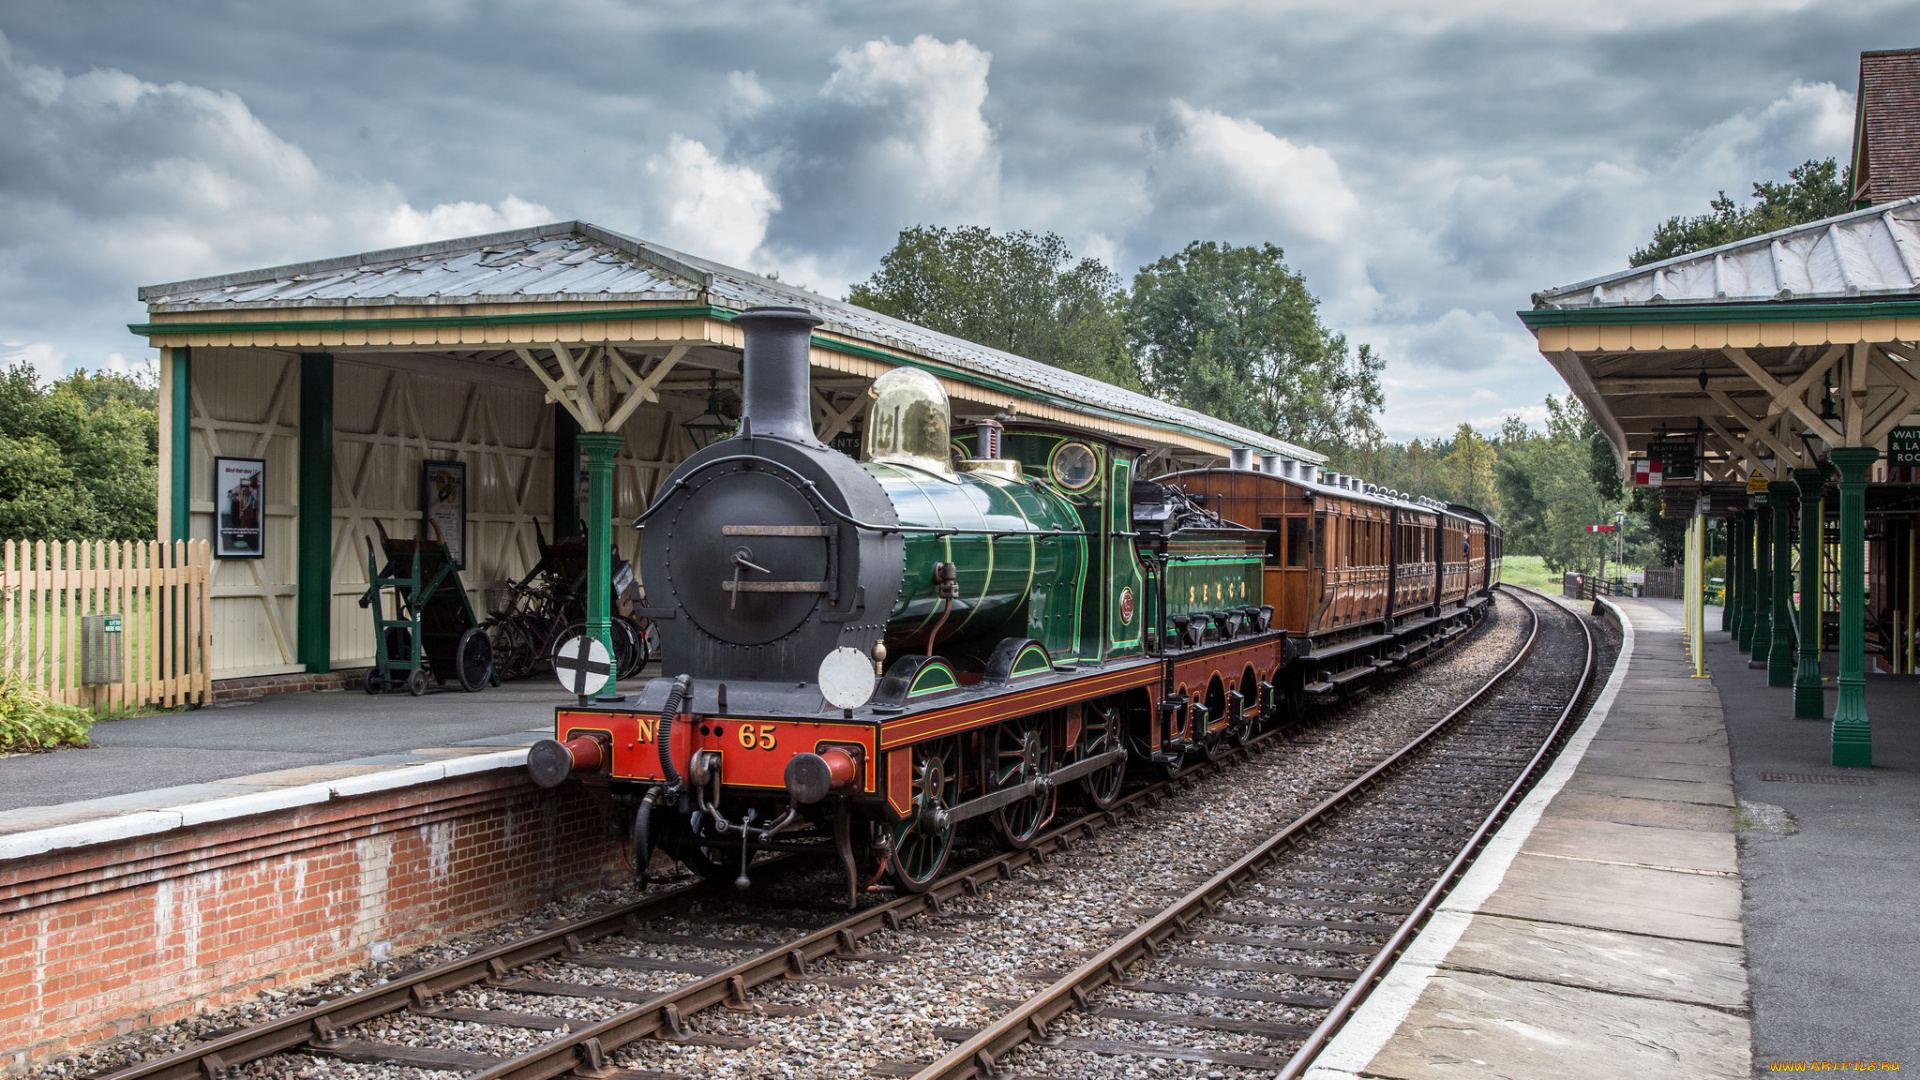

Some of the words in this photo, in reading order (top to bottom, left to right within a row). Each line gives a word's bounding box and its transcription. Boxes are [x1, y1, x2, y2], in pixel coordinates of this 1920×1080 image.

[831, 438, 860, 448] ENTS
[1892, 441, 1900, 450] &
[738, 723, 777, 751] 65
